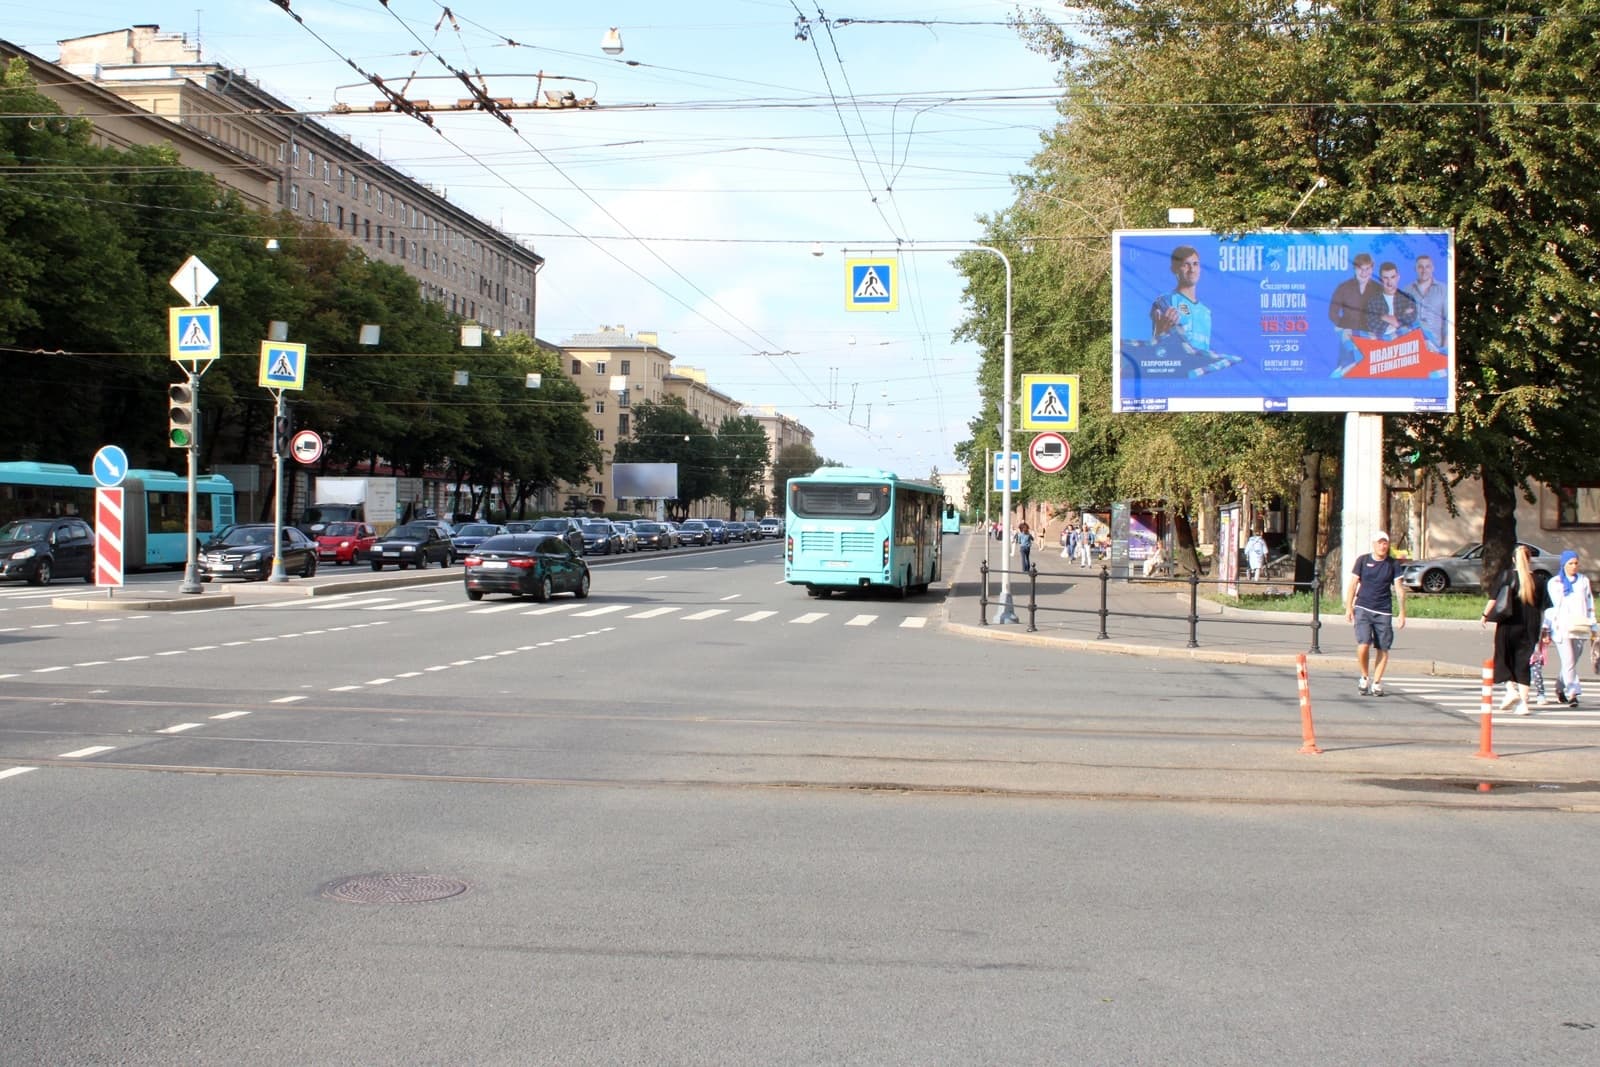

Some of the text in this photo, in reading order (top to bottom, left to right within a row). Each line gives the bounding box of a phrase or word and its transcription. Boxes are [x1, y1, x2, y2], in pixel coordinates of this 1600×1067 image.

[1219, 245, 1264, 271] ЗЕНИТ
[1286, 245, 1349, 272] ДИНАМО
[1260, 293, 1307, 308] 10 АВГУСТА
[1260, 320, 1309, 333] 15:30
[1269, 344, 1300, 352] 17:30
[1369, 339, 1420, 364] ИВАНУШКИ
